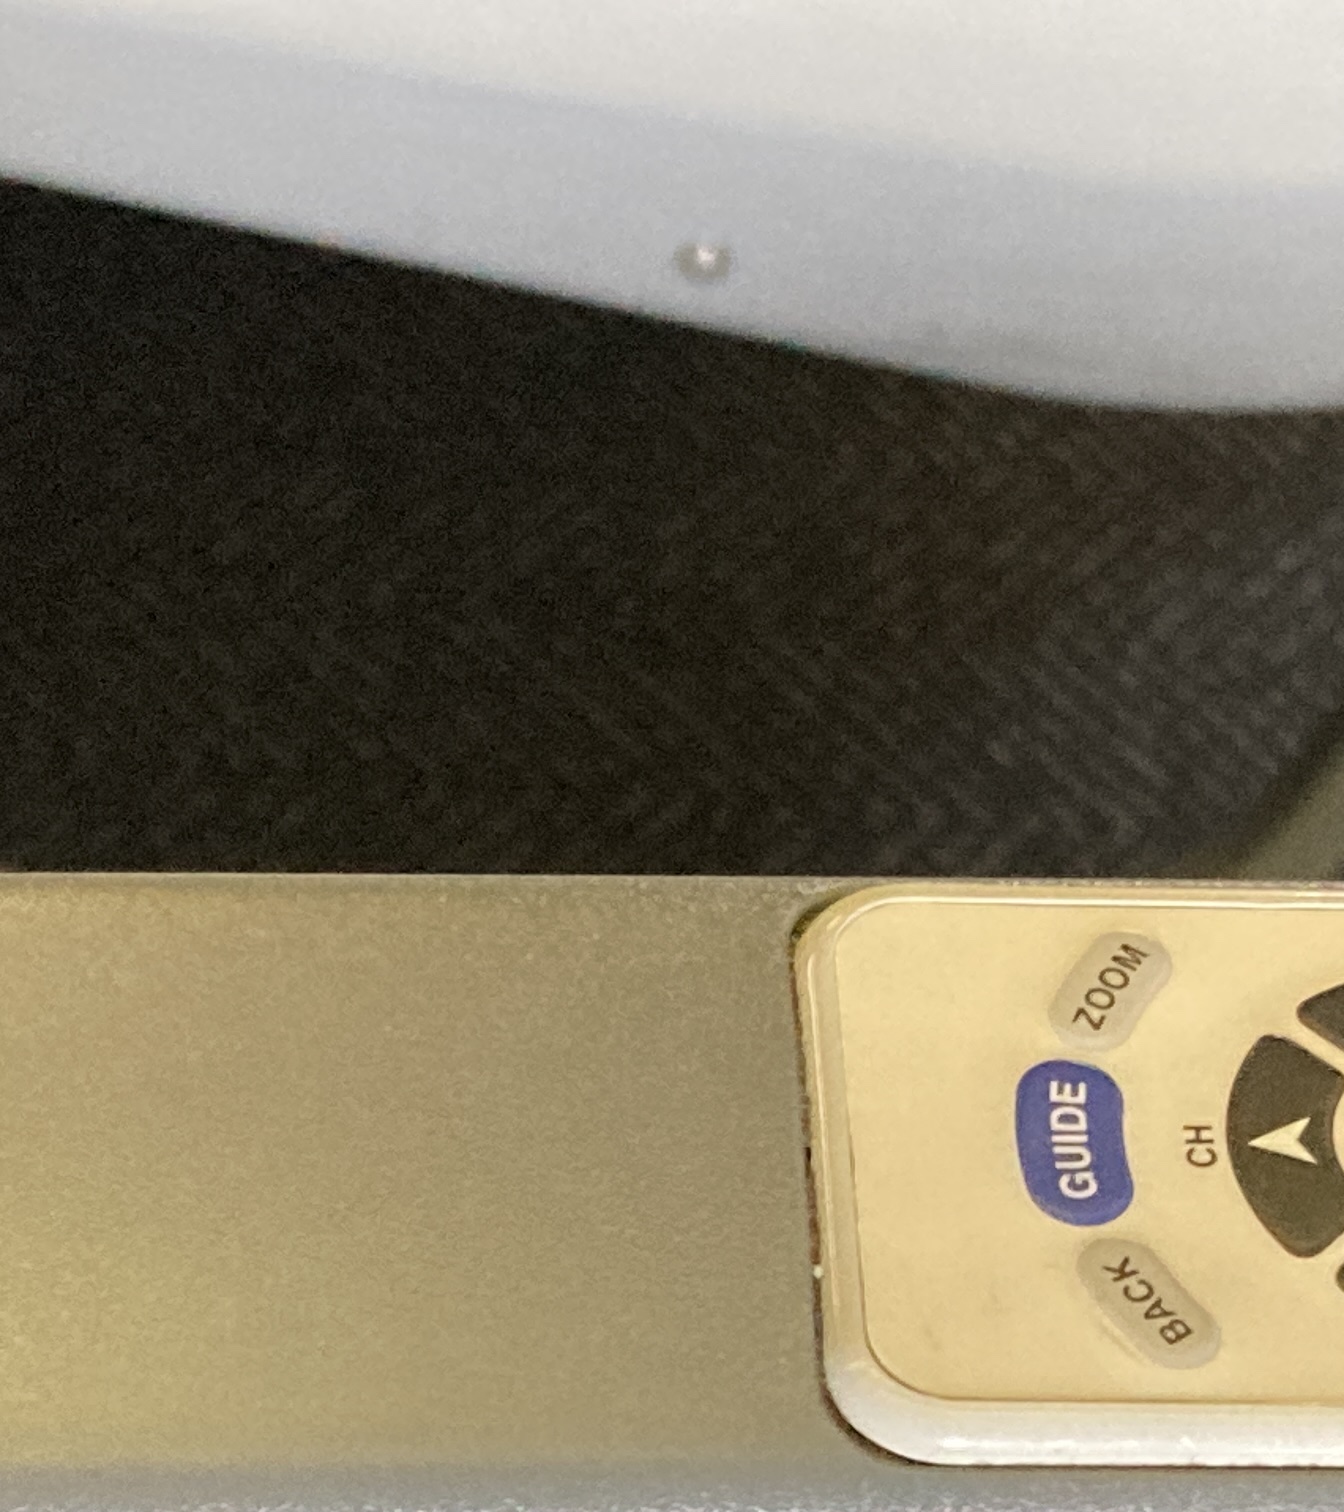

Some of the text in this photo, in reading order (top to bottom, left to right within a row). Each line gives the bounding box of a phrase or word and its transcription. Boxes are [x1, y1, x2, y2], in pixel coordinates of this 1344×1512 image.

[1072, 943, 1150, 1032] ZOOM
[1049, 1080, 1099, 1201] GUIDE
[1182, 1124, 1219, 1169] CH
[1102, 1256, 1194, 1346] BACK
